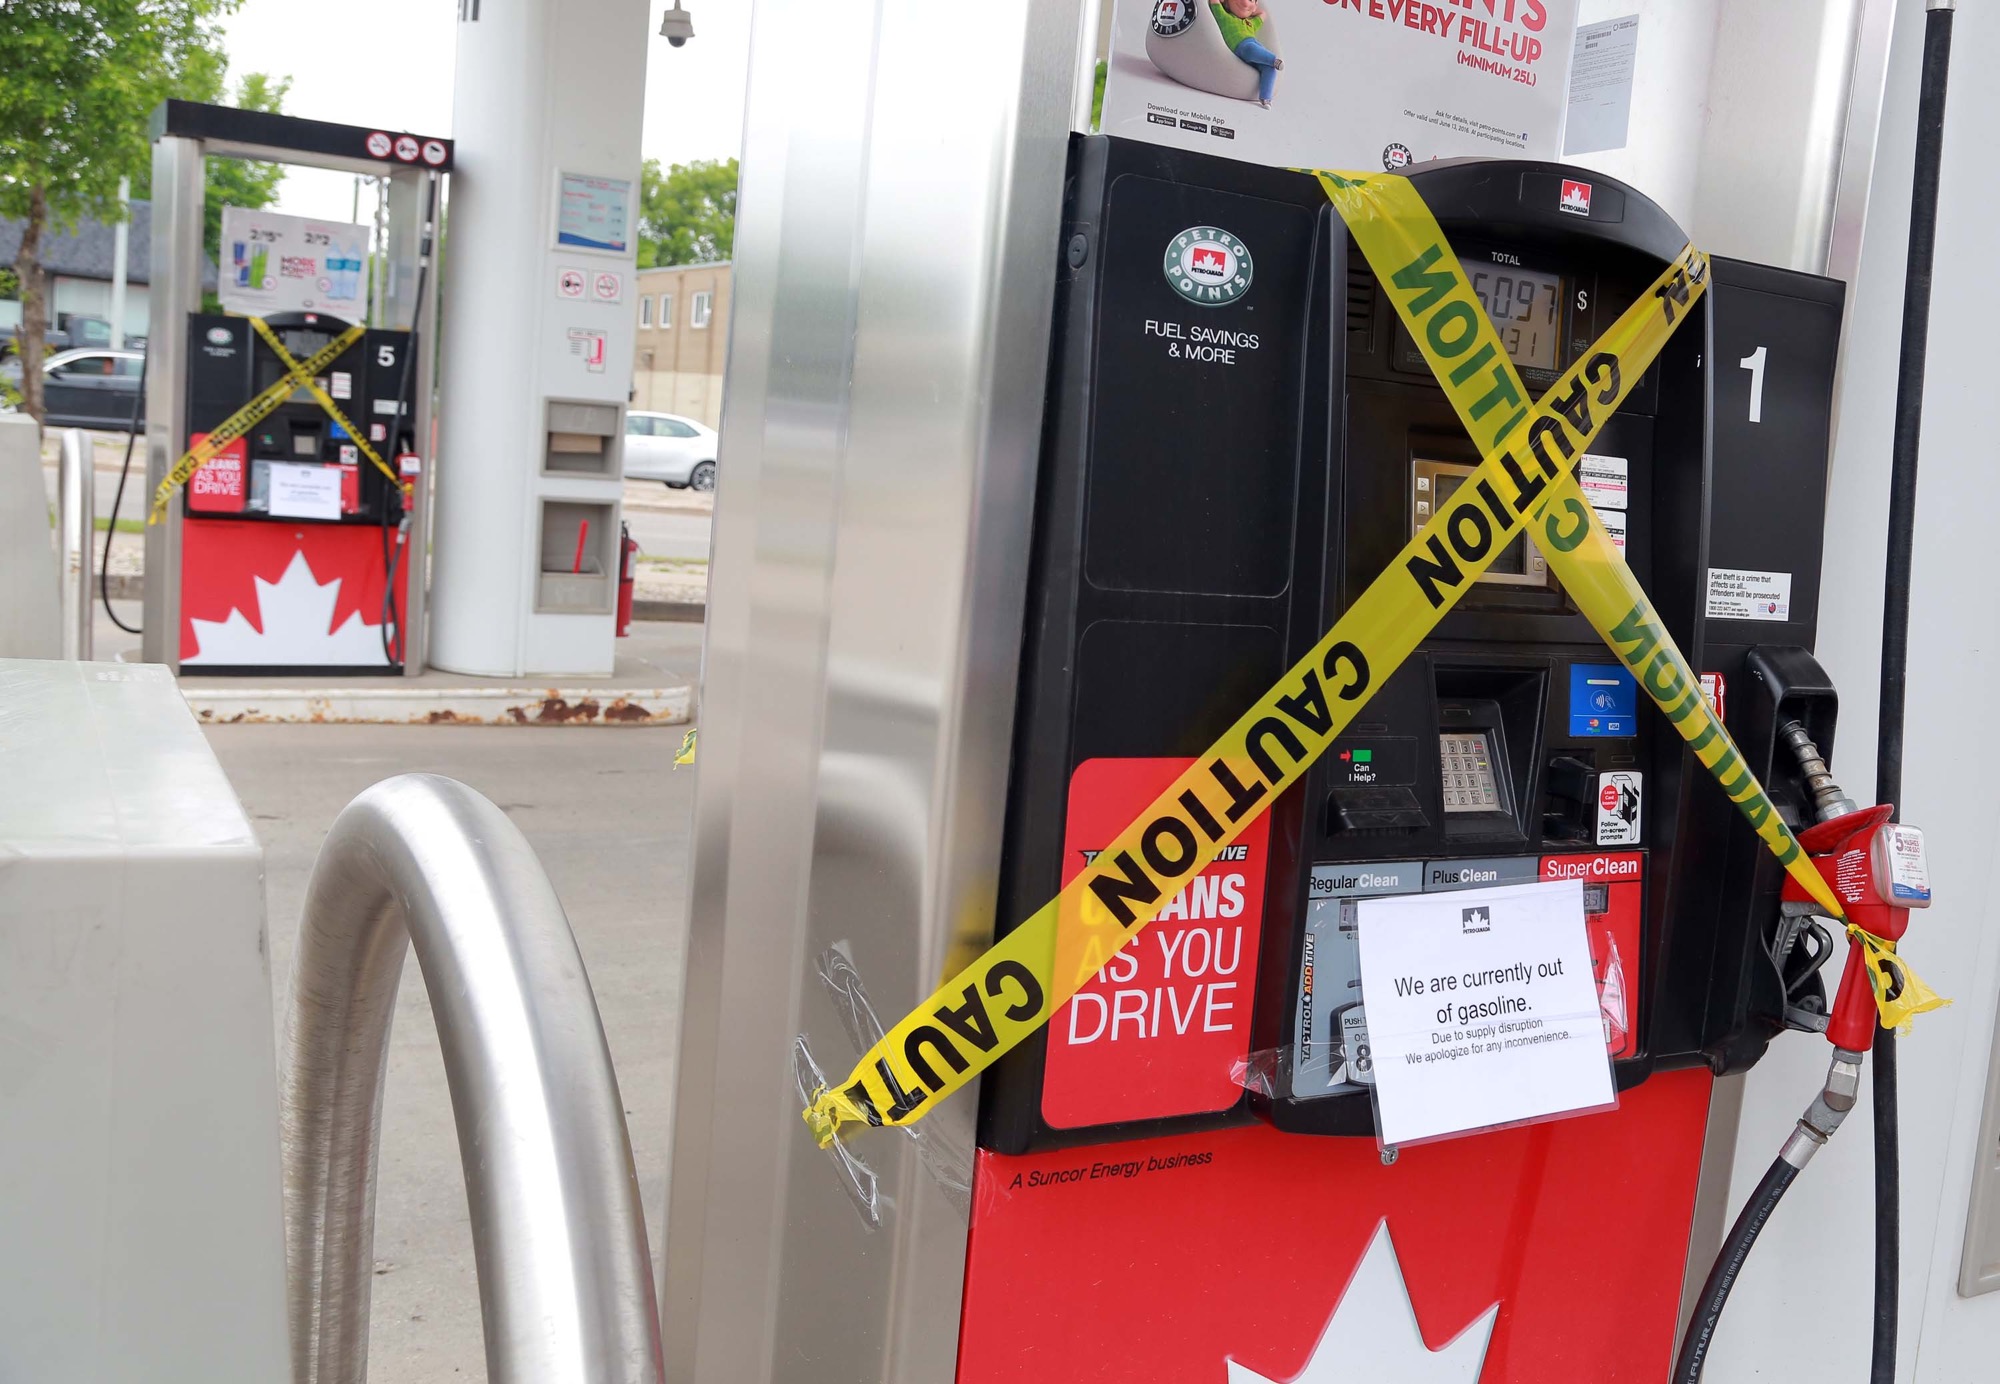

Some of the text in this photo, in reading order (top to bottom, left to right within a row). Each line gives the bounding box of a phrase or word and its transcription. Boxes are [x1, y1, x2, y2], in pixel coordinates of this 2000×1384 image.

[1369, 0, 1456, 38] EVERY
[1458, 15, 1542, 64] FILL-UP
[1457, 50, 1537, 87] (MINIMUM 25L)
[1147, 102, 1178, 114] Download
[1191, 112, 1211, 121] Mobile
[1212, 116, 1225, 124] App
[1404, 110, 1415, 118] Offer
[1416, 112, 1428, 122] valid
[1428, 116, 1438, 124] until
[1439, 119, 1450, 128] June
[1477, 132, 1504, 144] participating
[1452, 114, 1468, 126] details,
[1469, 118, 1478, 128] visit
[1479, 122, 1516, 138] petro-points.com
[1176, 230, 1245, 257] PETRO
[1492, 252, 1520, 266] TOTAL
[1169, 265, 1246, 300] POINTS
[1577, 289, 1588, 312] $
[1145, 320, 1259, 348] FUEL SAVINGS
[377, 346, 395, 367] 5
[1168, 342, 1235, 364] & MORE
[1740, 346, 1767, 423] 1
[1406, 352, 1621, 610] CAUTION
[1711, 572, 1722, 580] Fuel
[1723, 573, 1735, 581] theft
[1710, 589, 1735, 598] Offenders
[1753, 592, 1780, 600] prosecuted
[1354, 764, 1370, 772] Can
[1354, 773, 1376, 783] Help?
[1088, 640, 1370, 929] CAUTION
[1895, 832, 1904, 852] 5
[1157, 926, 1242, 980] YOU
[1303, 933, 1315, 994] ADDITIVE
[1394, 957, 1563, 998] We are currently out
[1068, 982, 1236, 1046] DRIVE
[1344, 1018, 1362, 1026] PUSH
[1436, 995, 1533, 1025] of gasoline.
[844, 960, 1044, 1127] CAUTI
[1302, 1002, 1312, 1062] TACTROL
[1405, 1028, 1571, 1065] We apologize for any inconvenience.
[1432, 1017, 1543, 1044] Due to supply disruption
[1010, 1150, 1213, 1190] A Suncor Energy business
[1690, 1314, 1716, 1376] FUTURA
[1712, 1285, 1726, 1312] GASOLINE
[1735, 1248, 1745, 1263] MADE
